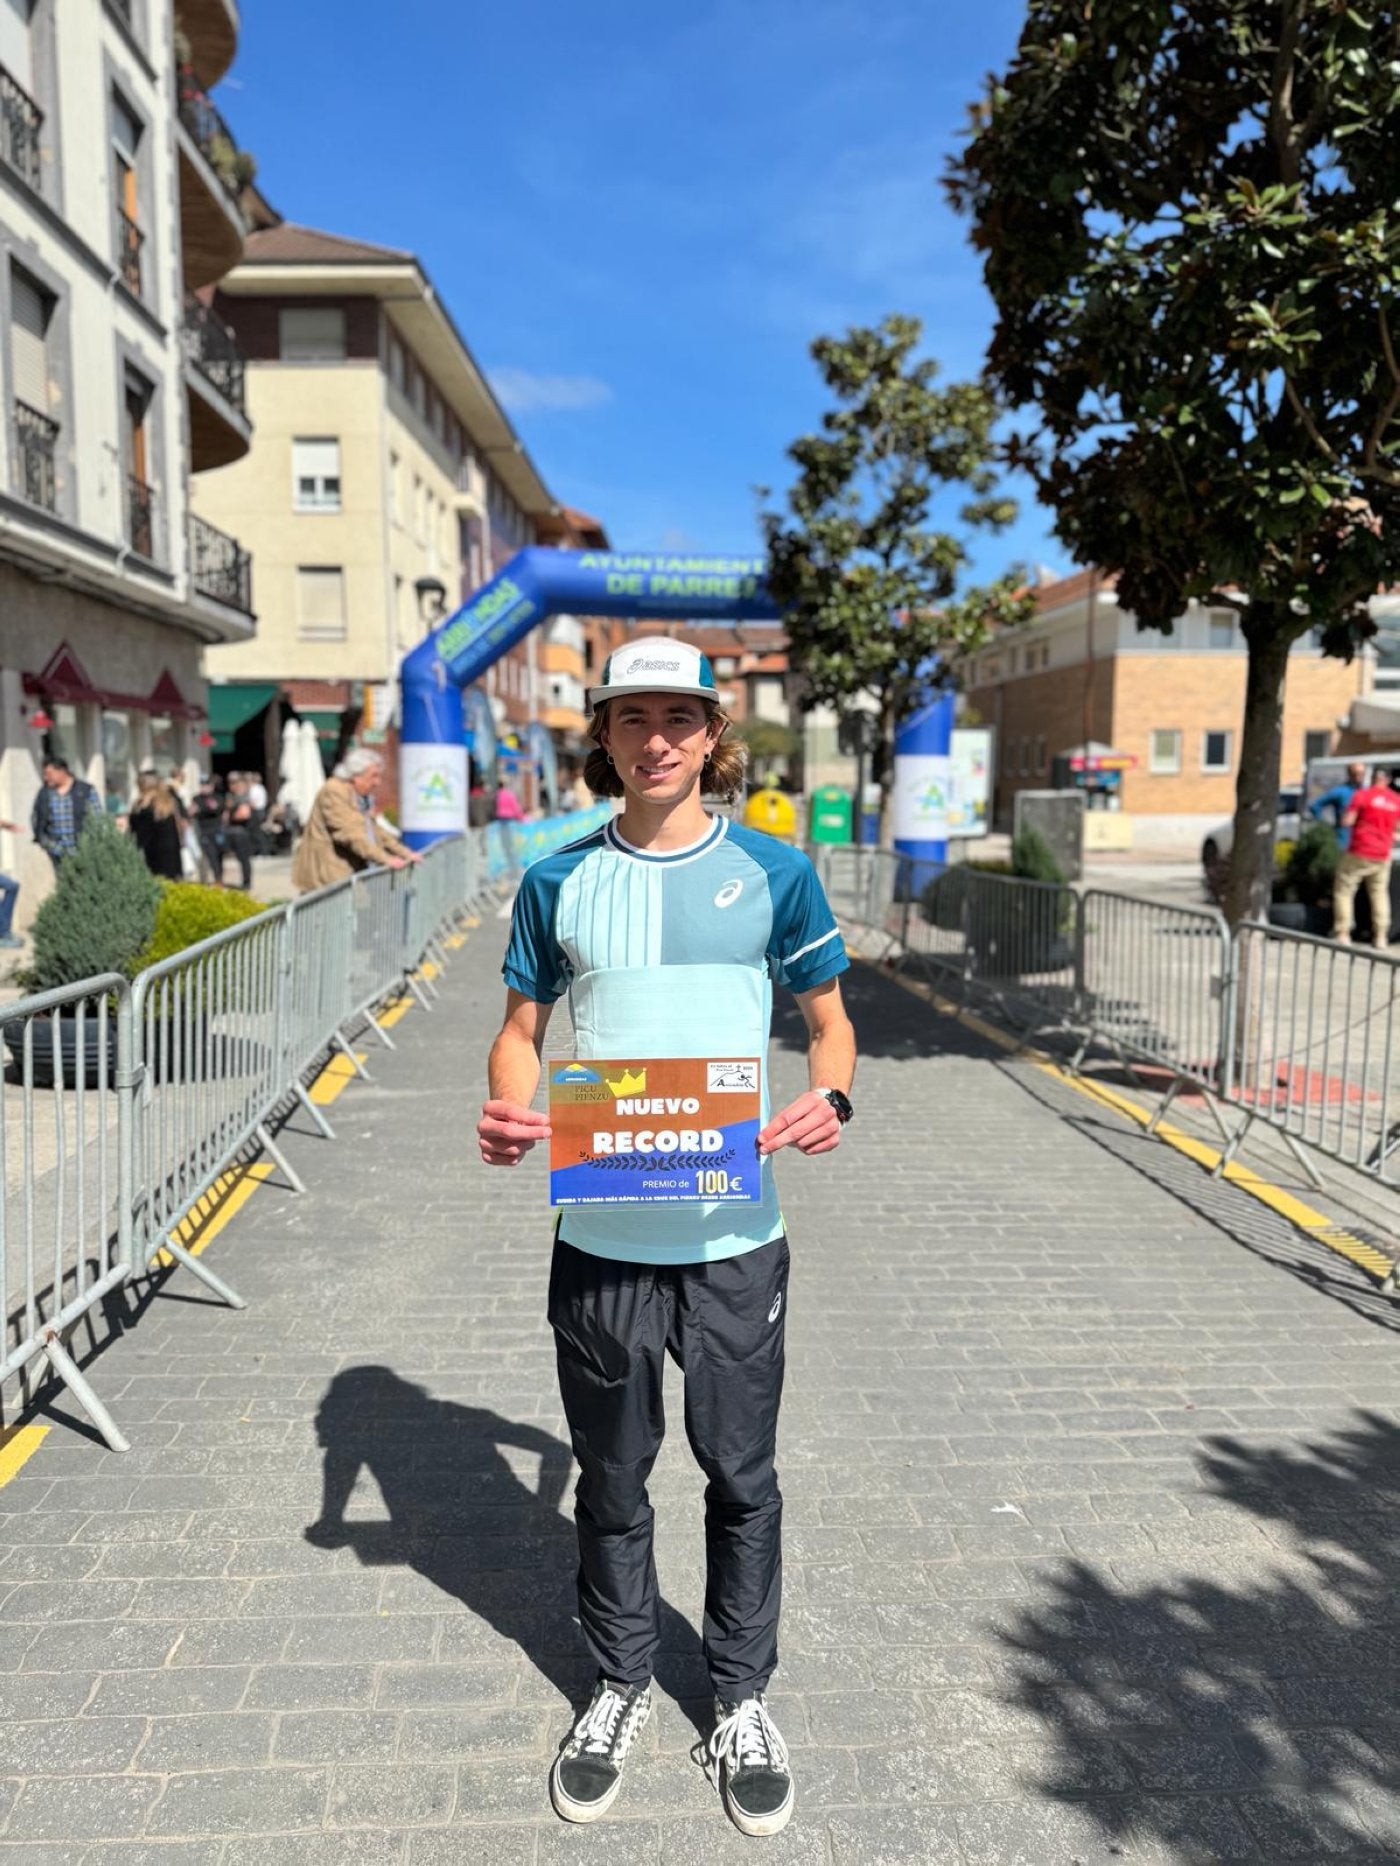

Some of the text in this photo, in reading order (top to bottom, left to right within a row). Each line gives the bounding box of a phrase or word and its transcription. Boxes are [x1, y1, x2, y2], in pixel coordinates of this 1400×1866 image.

[579, 553, 763, 575] AYUNTAMIENT
[606, 573, 643, 595] DE
[616, 1097, 700, 1115] NUEVO
[592, 1129, 724, 1154] RECORD
[642, 1180, 677, 1189] PREMIO
[678, 1179, 690, 1188] de
